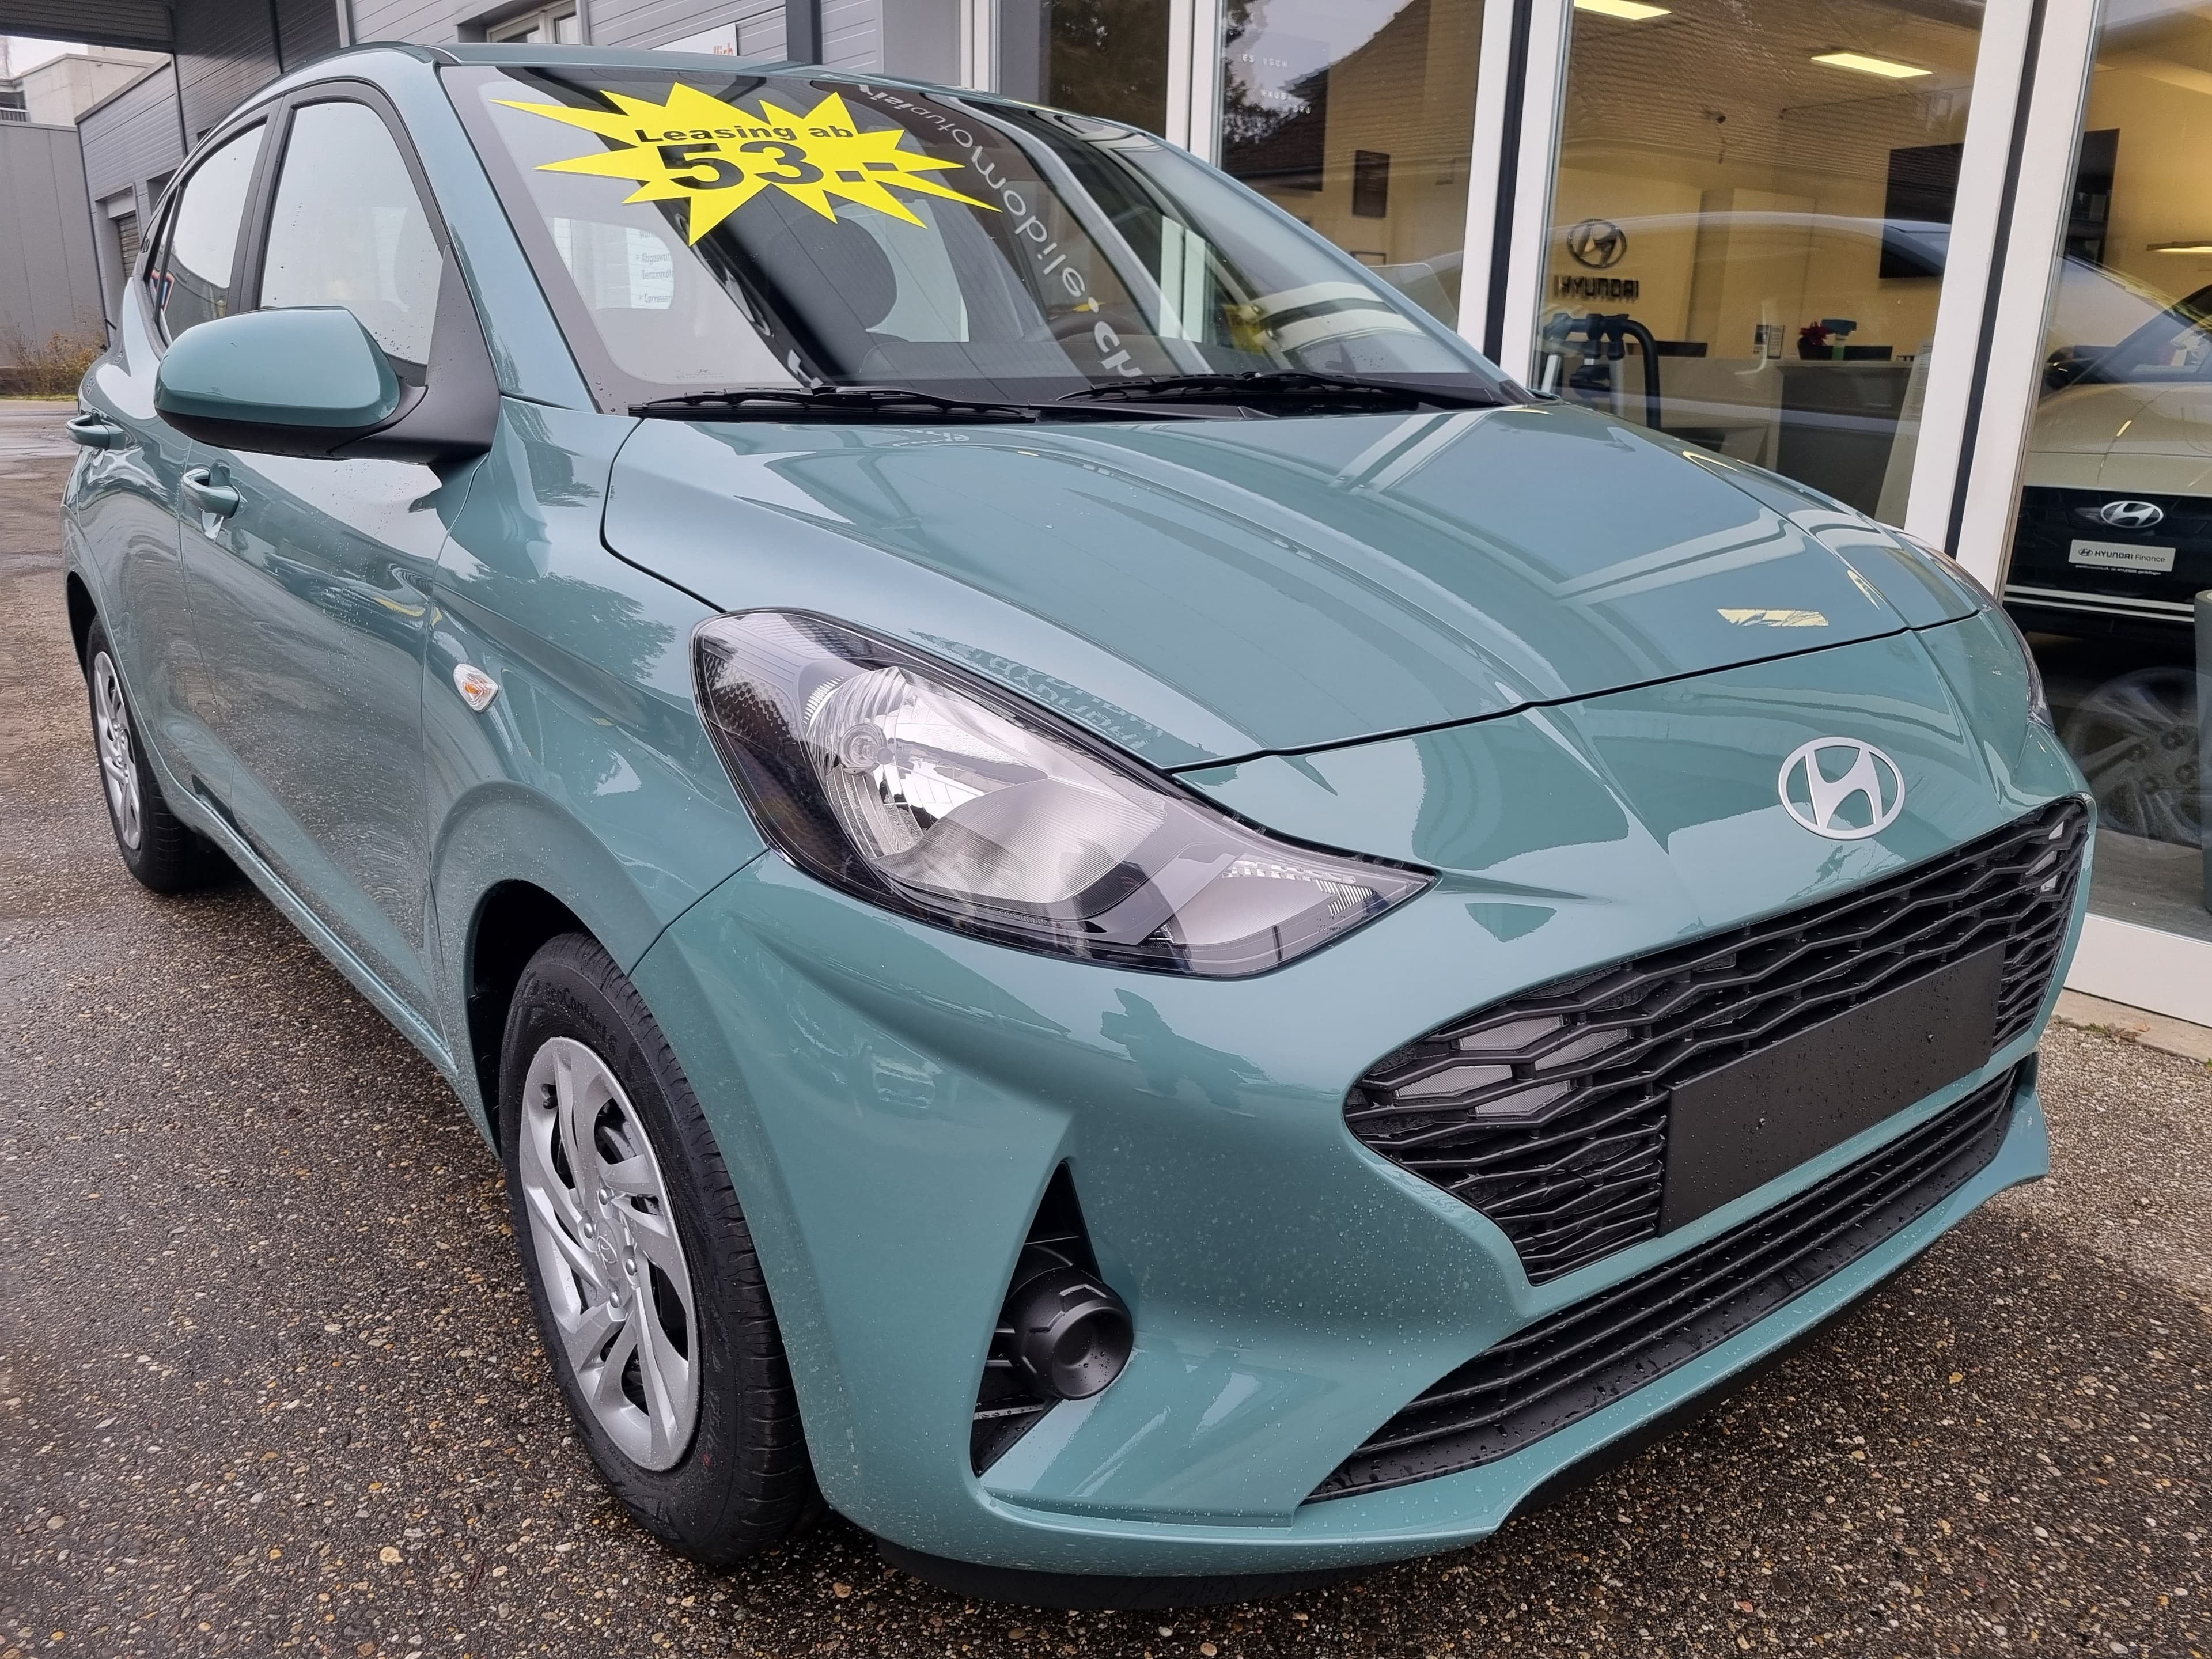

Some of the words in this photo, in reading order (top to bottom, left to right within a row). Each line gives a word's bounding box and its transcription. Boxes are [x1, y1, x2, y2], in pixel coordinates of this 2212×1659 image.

[635, 124, 797, 143] Leasing
[808, 125, 854, 138] ab
[1553, 275, 1639, 301] HYUNDAI
[2094, 550, 2134, 560] HYUNDAI
[2134, 554, 2166, 563] Finance
